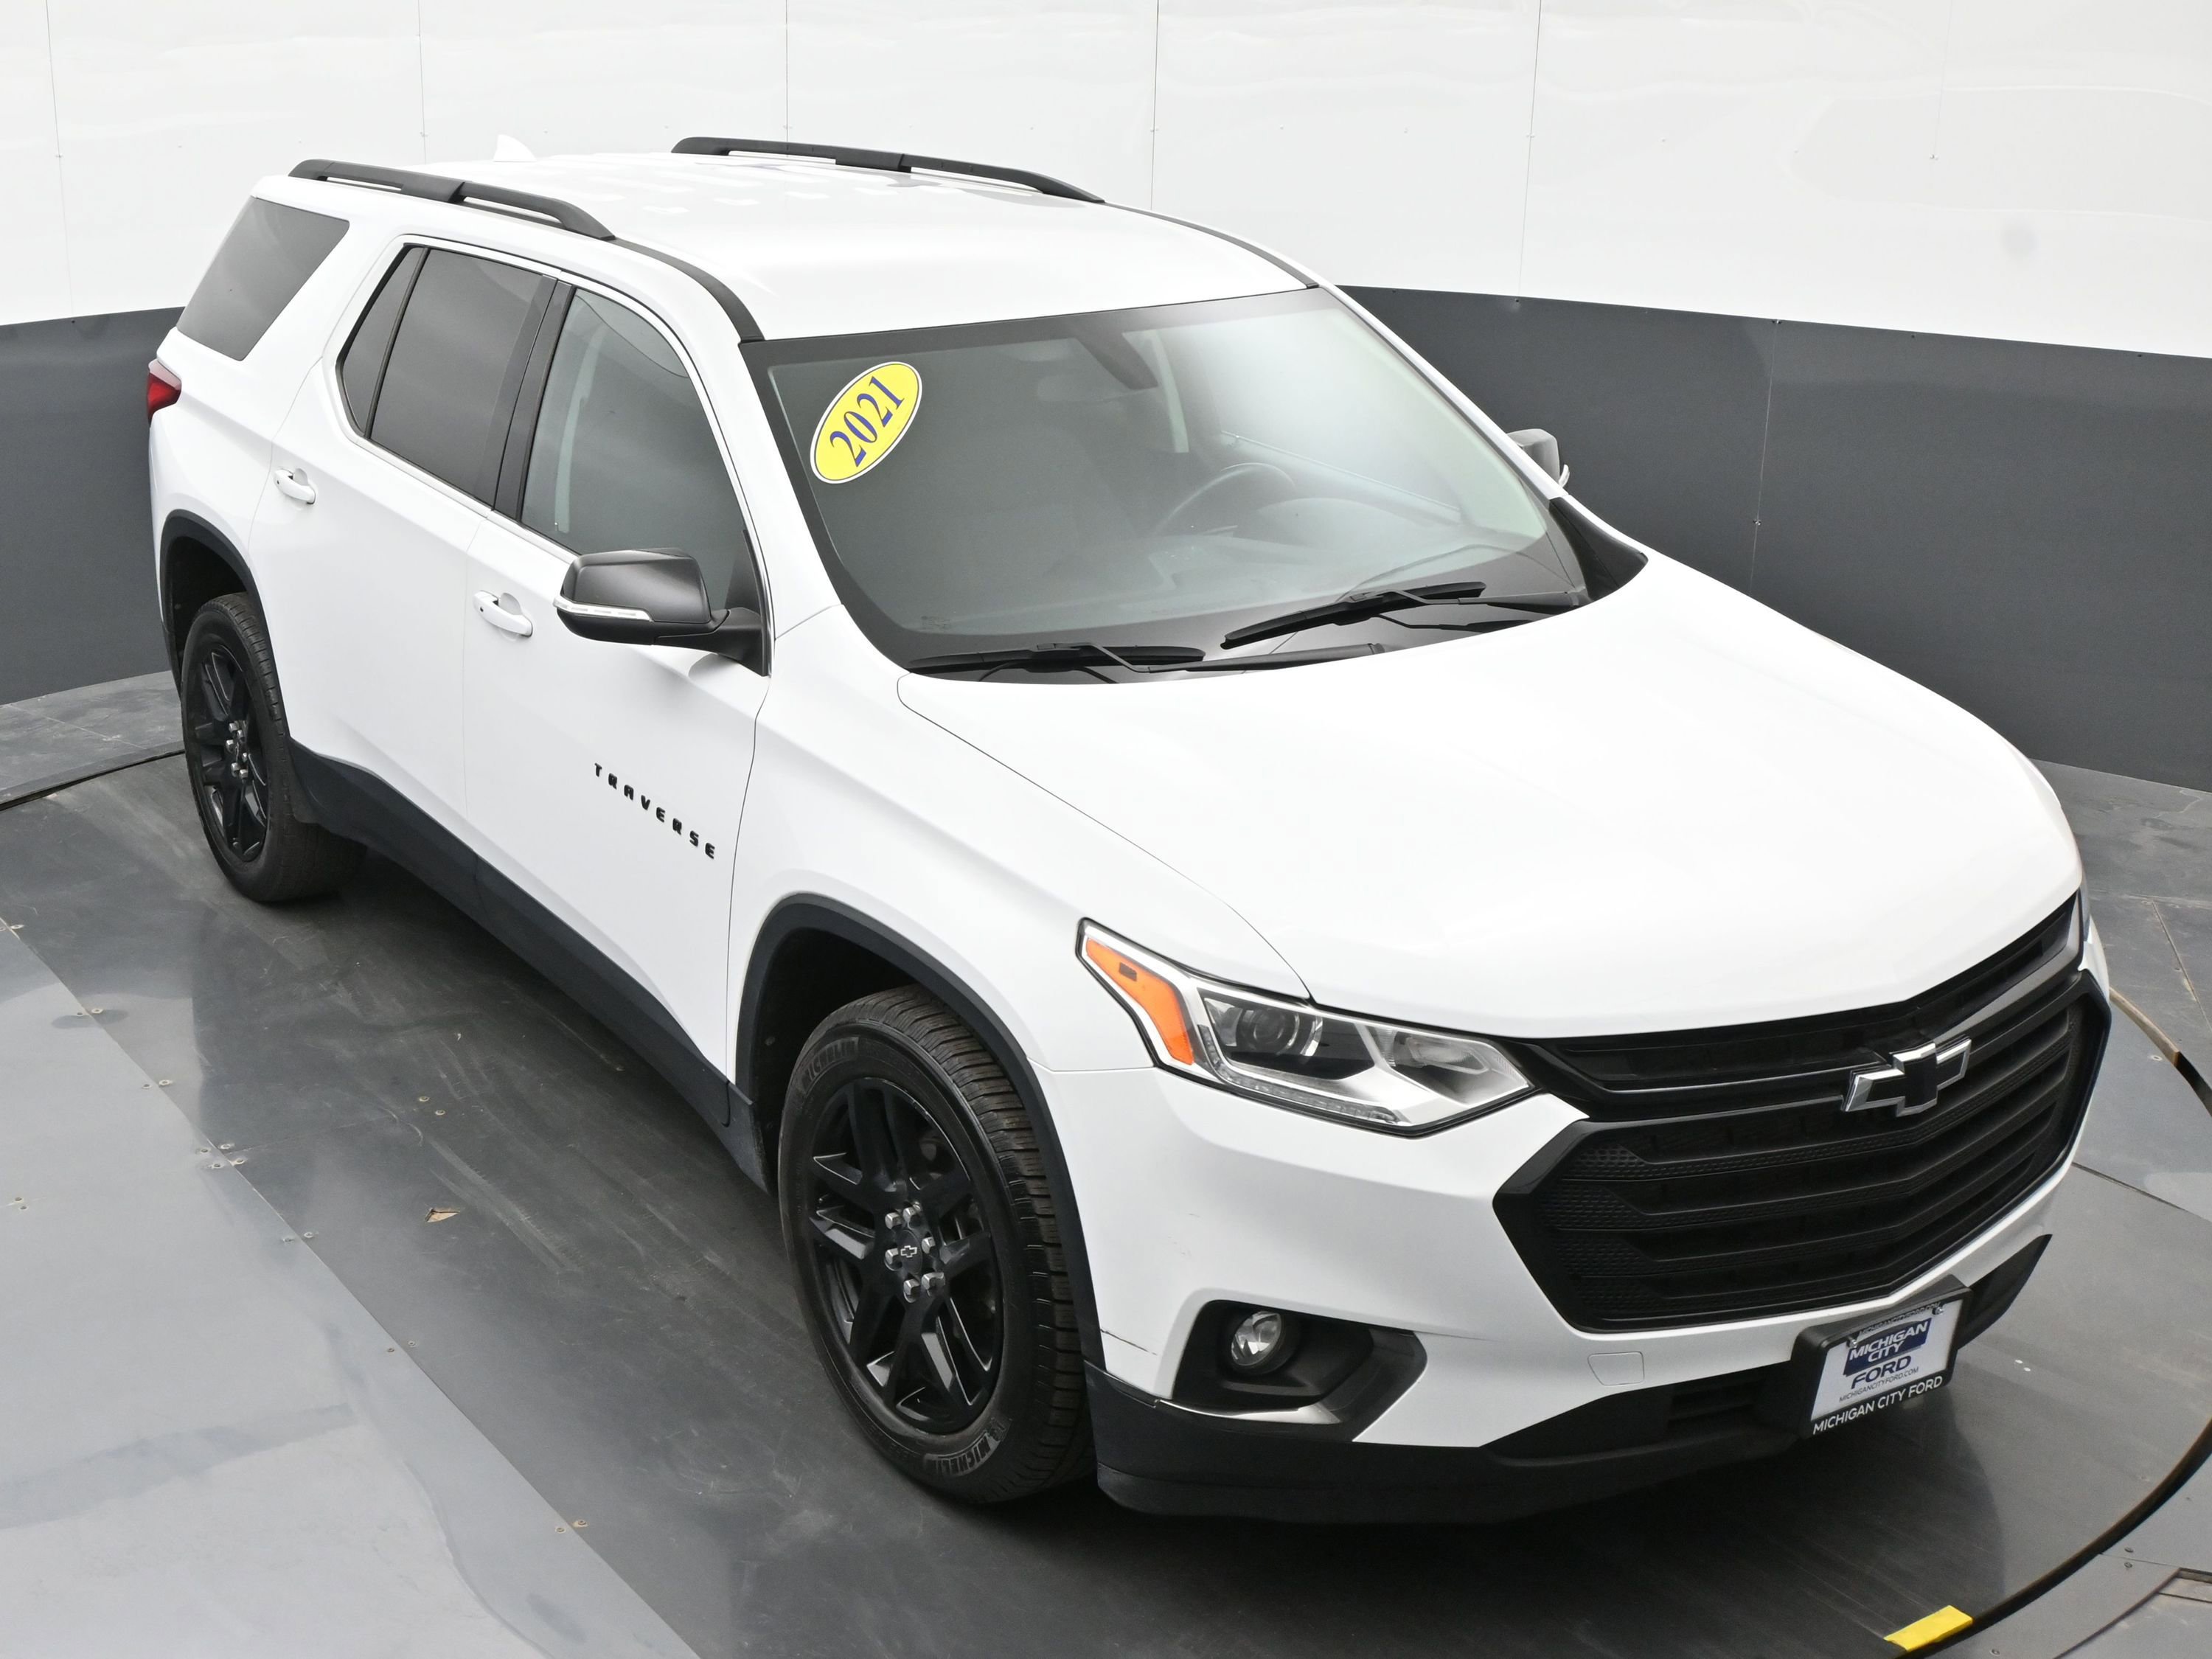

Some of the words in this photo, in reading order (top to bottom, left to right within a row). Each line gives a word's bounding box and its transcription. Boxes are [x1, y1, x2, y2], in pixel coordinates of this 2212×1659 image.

[830, 376, 905, 467] 2021
[594, 762, 715, 860] TRAVERSE
[1849, 1321, 1929, 1360] MICHIGAN
[1868, 1340, 1905, 1363] CITY
[1839, 1366, 1919, 1402] MICHIGANCITYFORD.COM
[1851, 1355, 1912, 1390] FORD
[1812, 1400, 1875, 1435] MICHIGAN
[1877, 1388, 1906, 1409] CITY
[1908, 1375, 1943, 1398] FORD
[927, 1434, 992, 1475] MICHELIN
